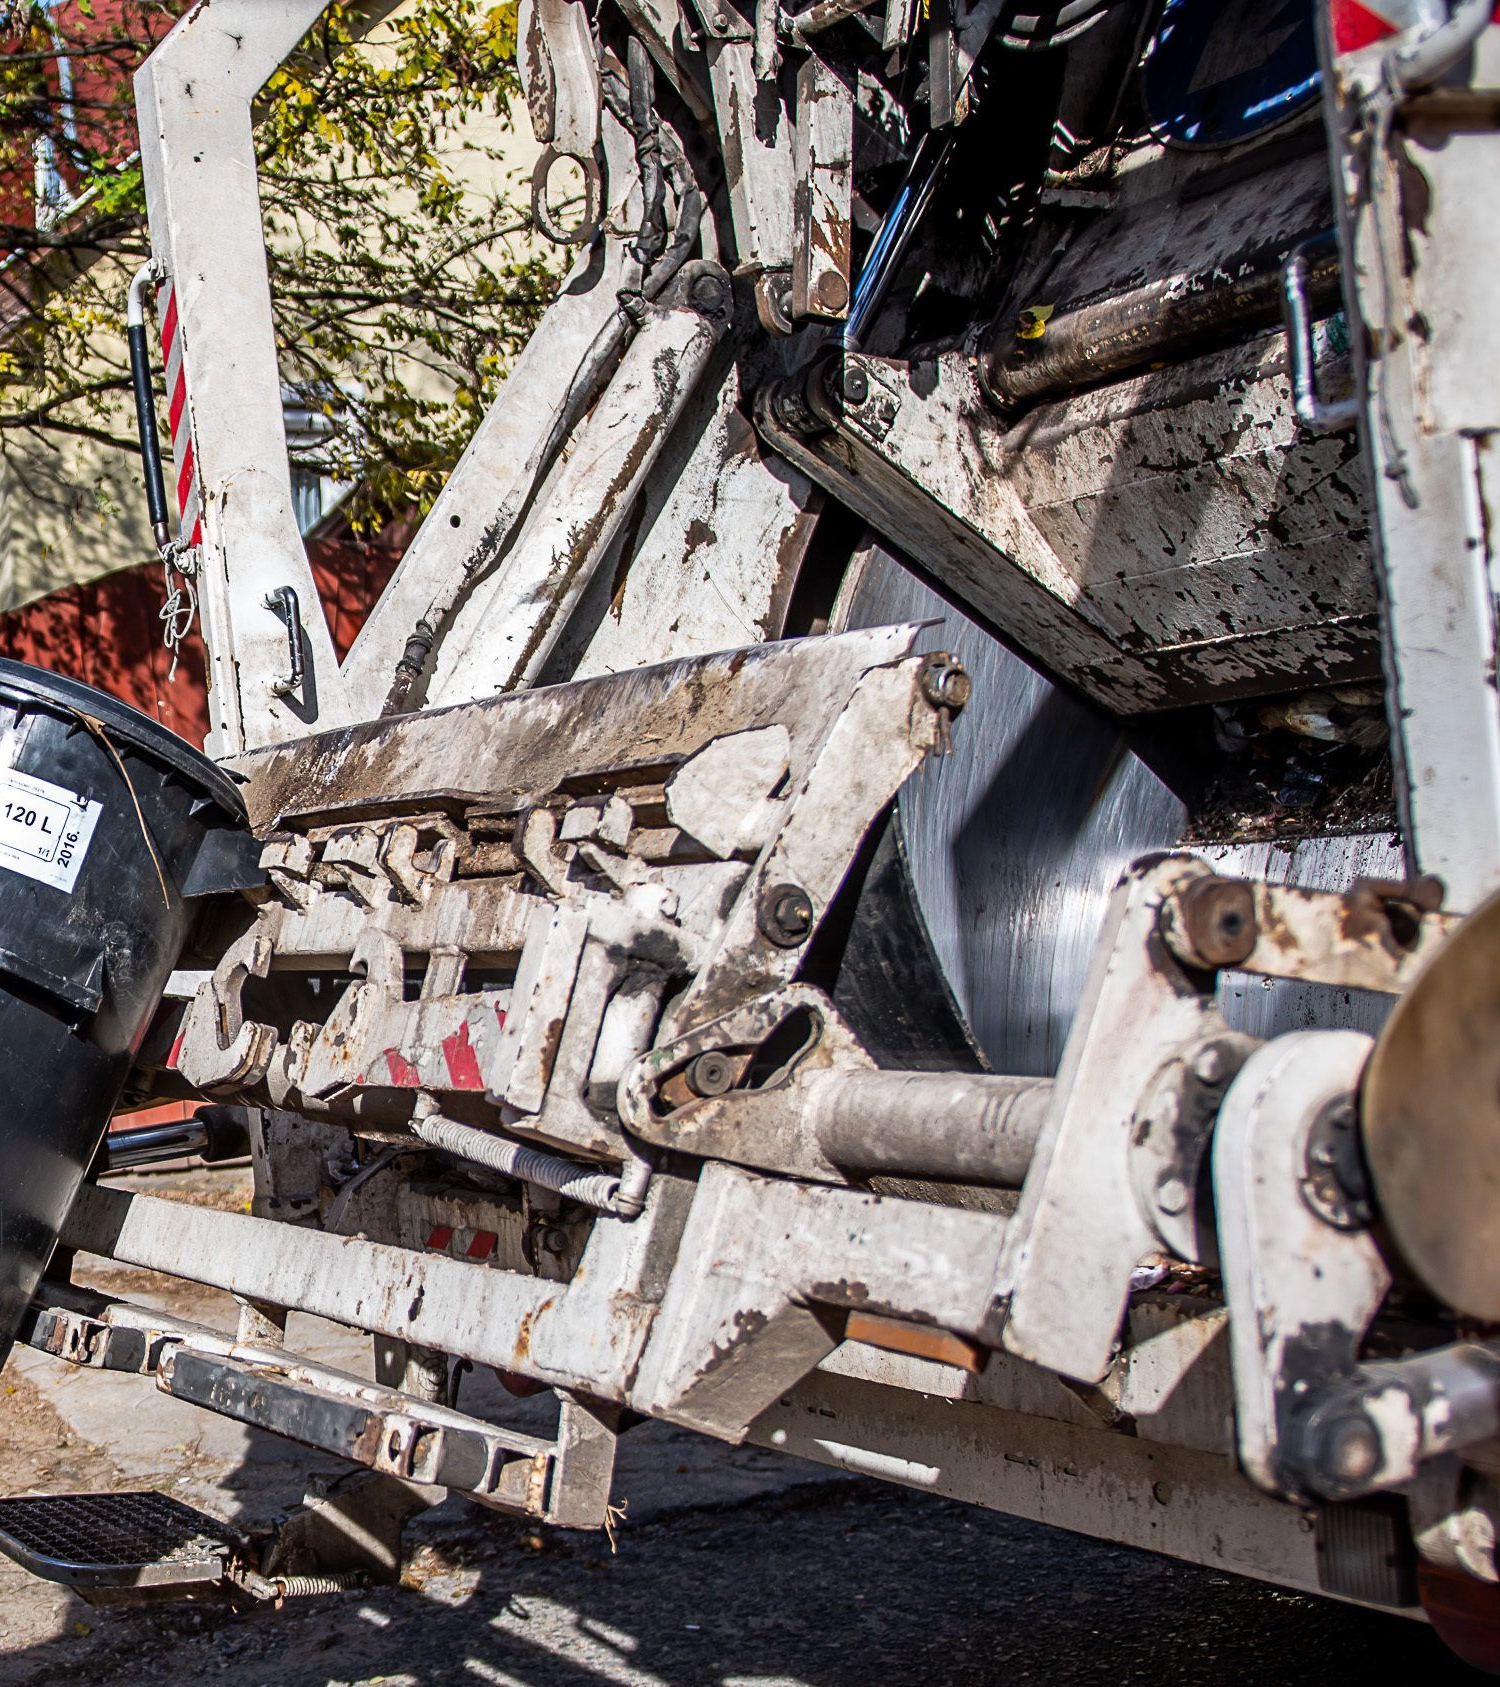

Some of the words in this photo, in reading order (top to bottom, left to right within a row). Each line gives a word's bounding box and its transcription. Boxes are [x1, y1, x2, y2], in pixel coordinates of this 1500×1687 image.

[4, 802, 37, 827] 120
[41, 815, 53, 835] L
[56, 830, 80, 868] 2016.
